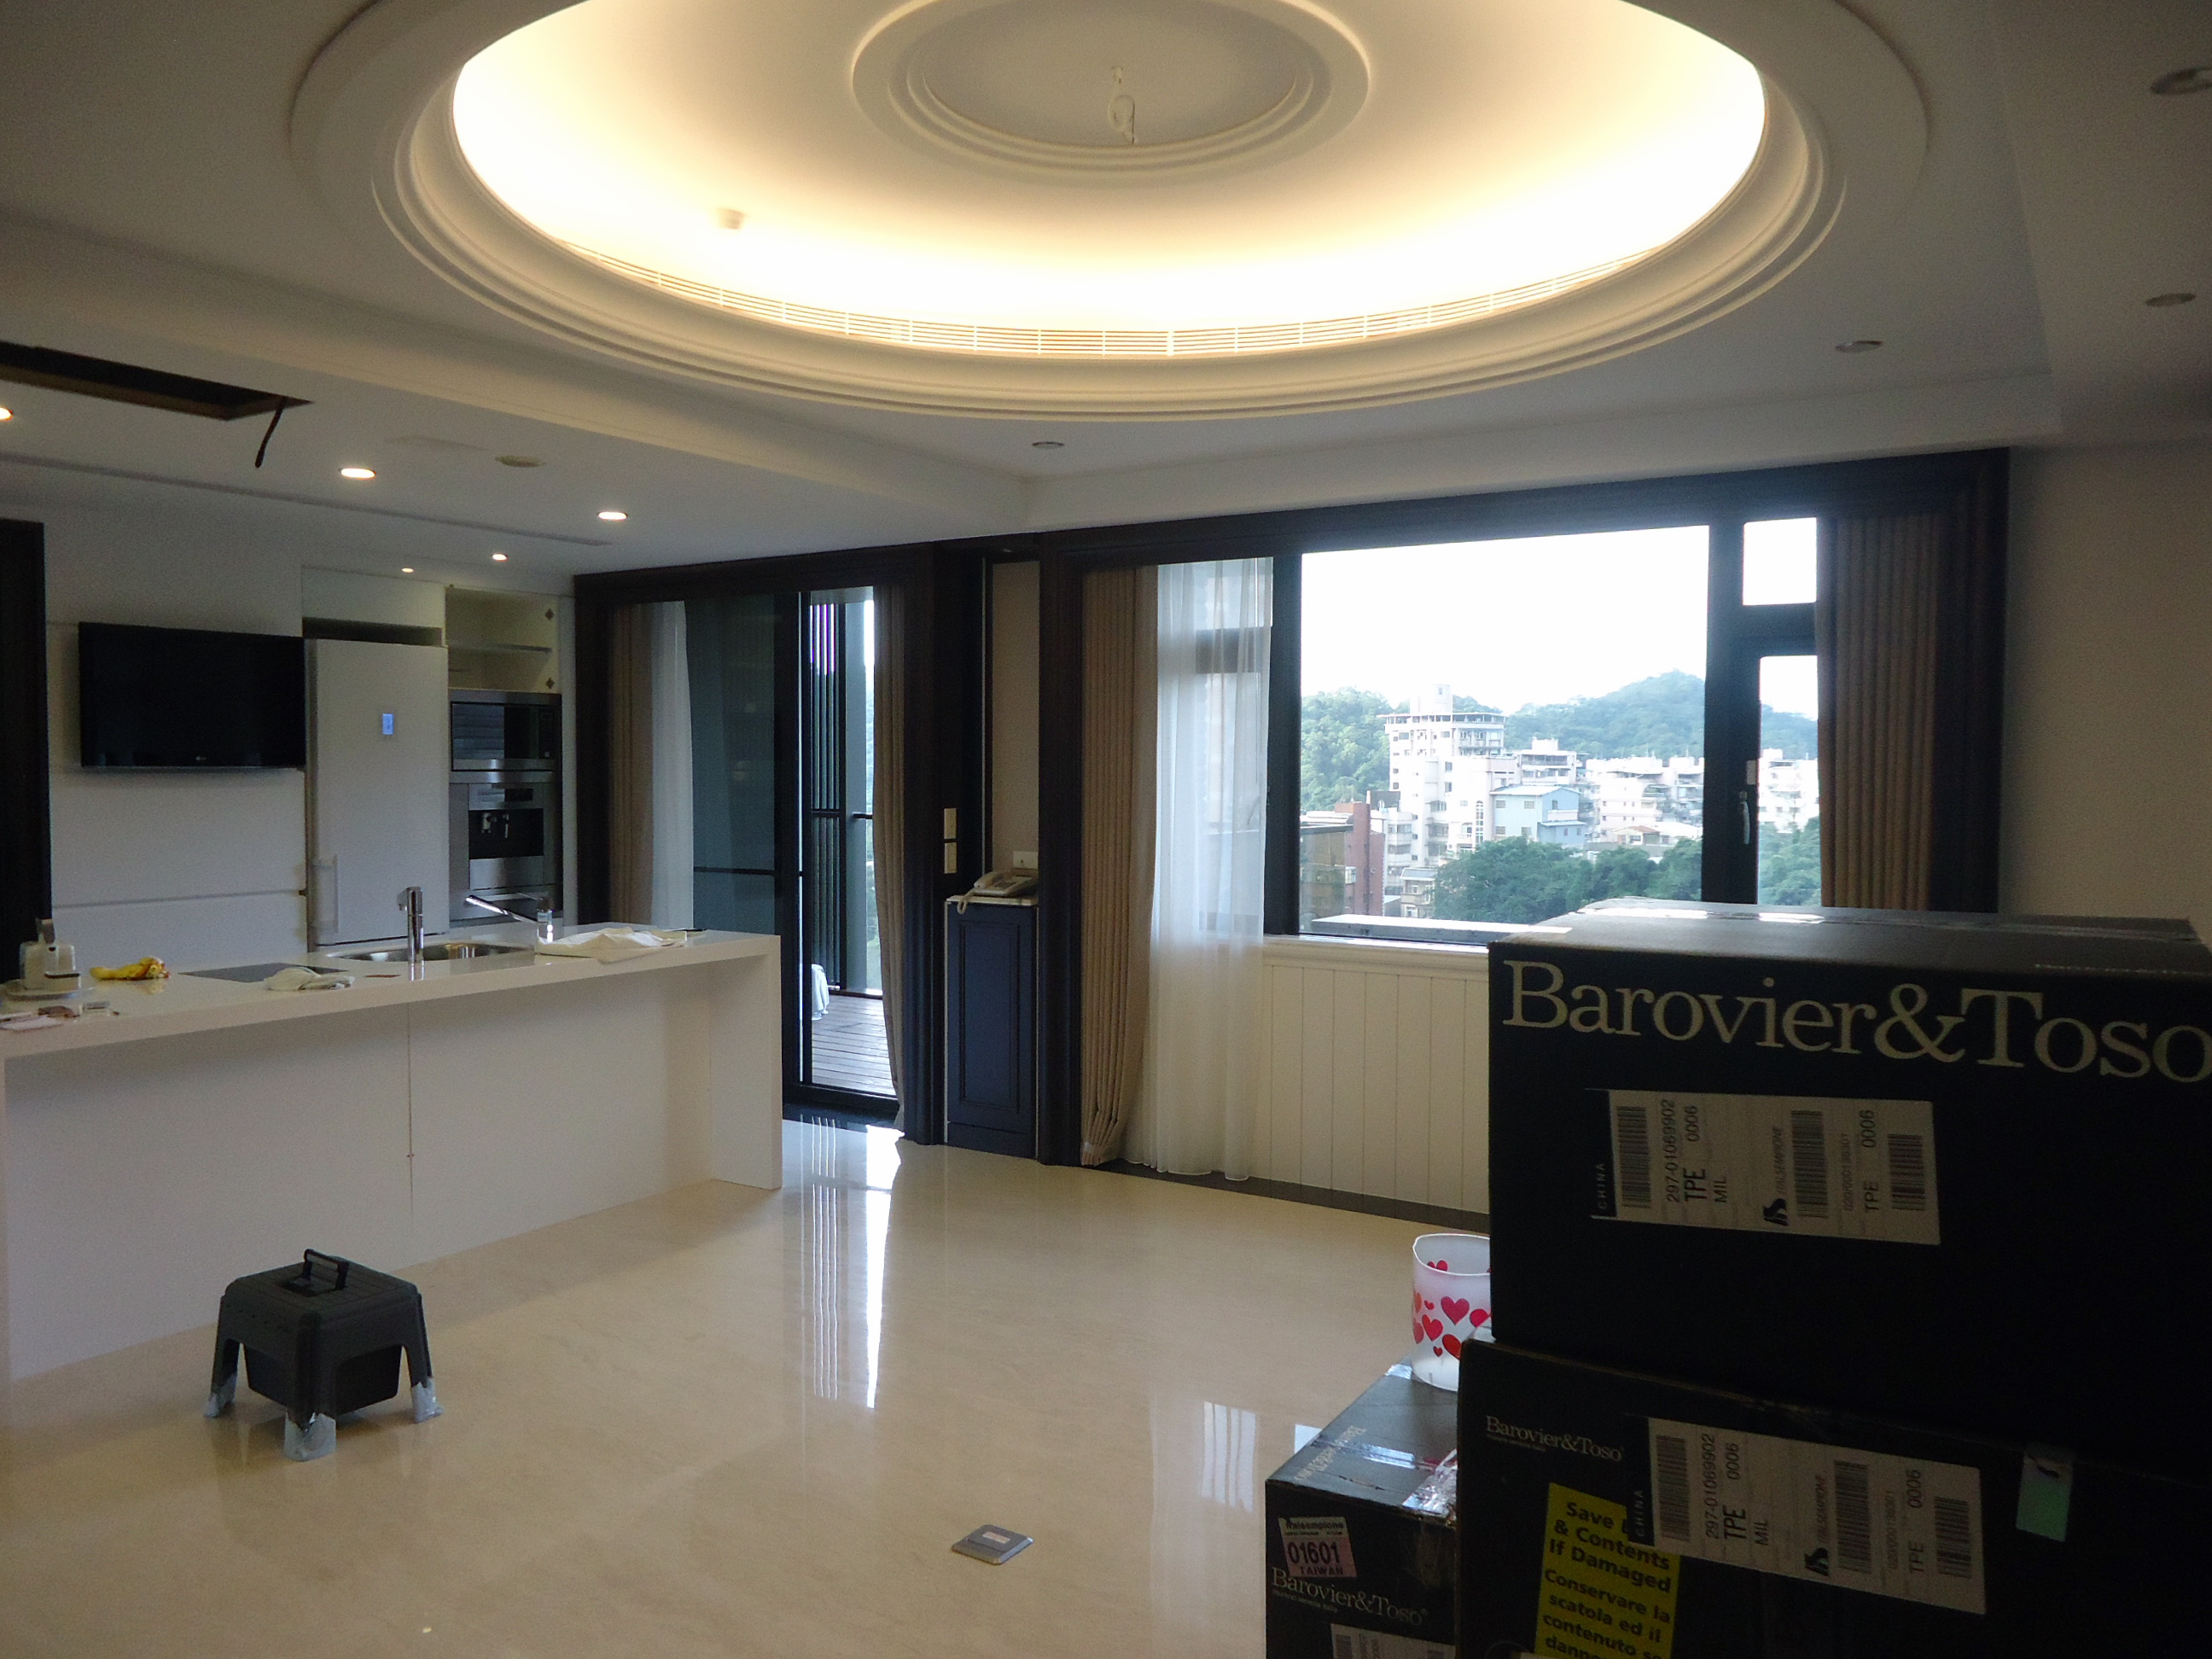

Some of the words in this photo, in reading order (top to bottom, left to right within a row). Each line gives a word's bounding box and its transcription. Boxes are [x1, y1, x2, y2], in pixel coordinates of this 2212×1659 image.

[1502, 959, 2212, 1083] Barovier&Toso
[1684, 1104, 1699, 1143] 0006
[1860, 1109, 1877, 1149] 0006
[1597, 1162, 1606, 1210] CHINA
[1684, 1167, 1707, 1202] TPE
[1714, 1176, 1728, 1203] MIL
[1860, 1179, 1879, 1213] TPE
[1485, 1415, 1622, 1462] Barovier&Toso
[1724, 1441, 1740, 1481] 0006
[1905, 1468, 1924, 1509] 0006
[1566, 1501, 1615, 1529] Save
[1635, 1488, 1645, 1538] CHINA
[1723, 1504, 1747, 1540] TPE
[1755, 1518, 1769, 1546] MIL
[1288, 1541, 1340, 1564] 01601
[1554, 1519, 1569, 1536] &
[1576, 1527, 1670, 1570] Contents
[1908, 1540, 1925, 1575] TPE
[1300, 1566, 1343, 1575] TAIWAN
[1550, 1539, 1565, 1556] If
[1572, 1545, 1671, 1593] Damaged
[1272, 1566, 1423, 1626] Barovier&Toso
[1545, 1569, 1647, 1615] Conservare
[1653, 1604, 1671, 1624] la
[1543, 1615, 1637, 1656] contenuto
[1550, 1594, 1613, 1626] scatola
[1619, 1620, 1643, 1637] ed
[1649, 1627, 1662, 1643] il
